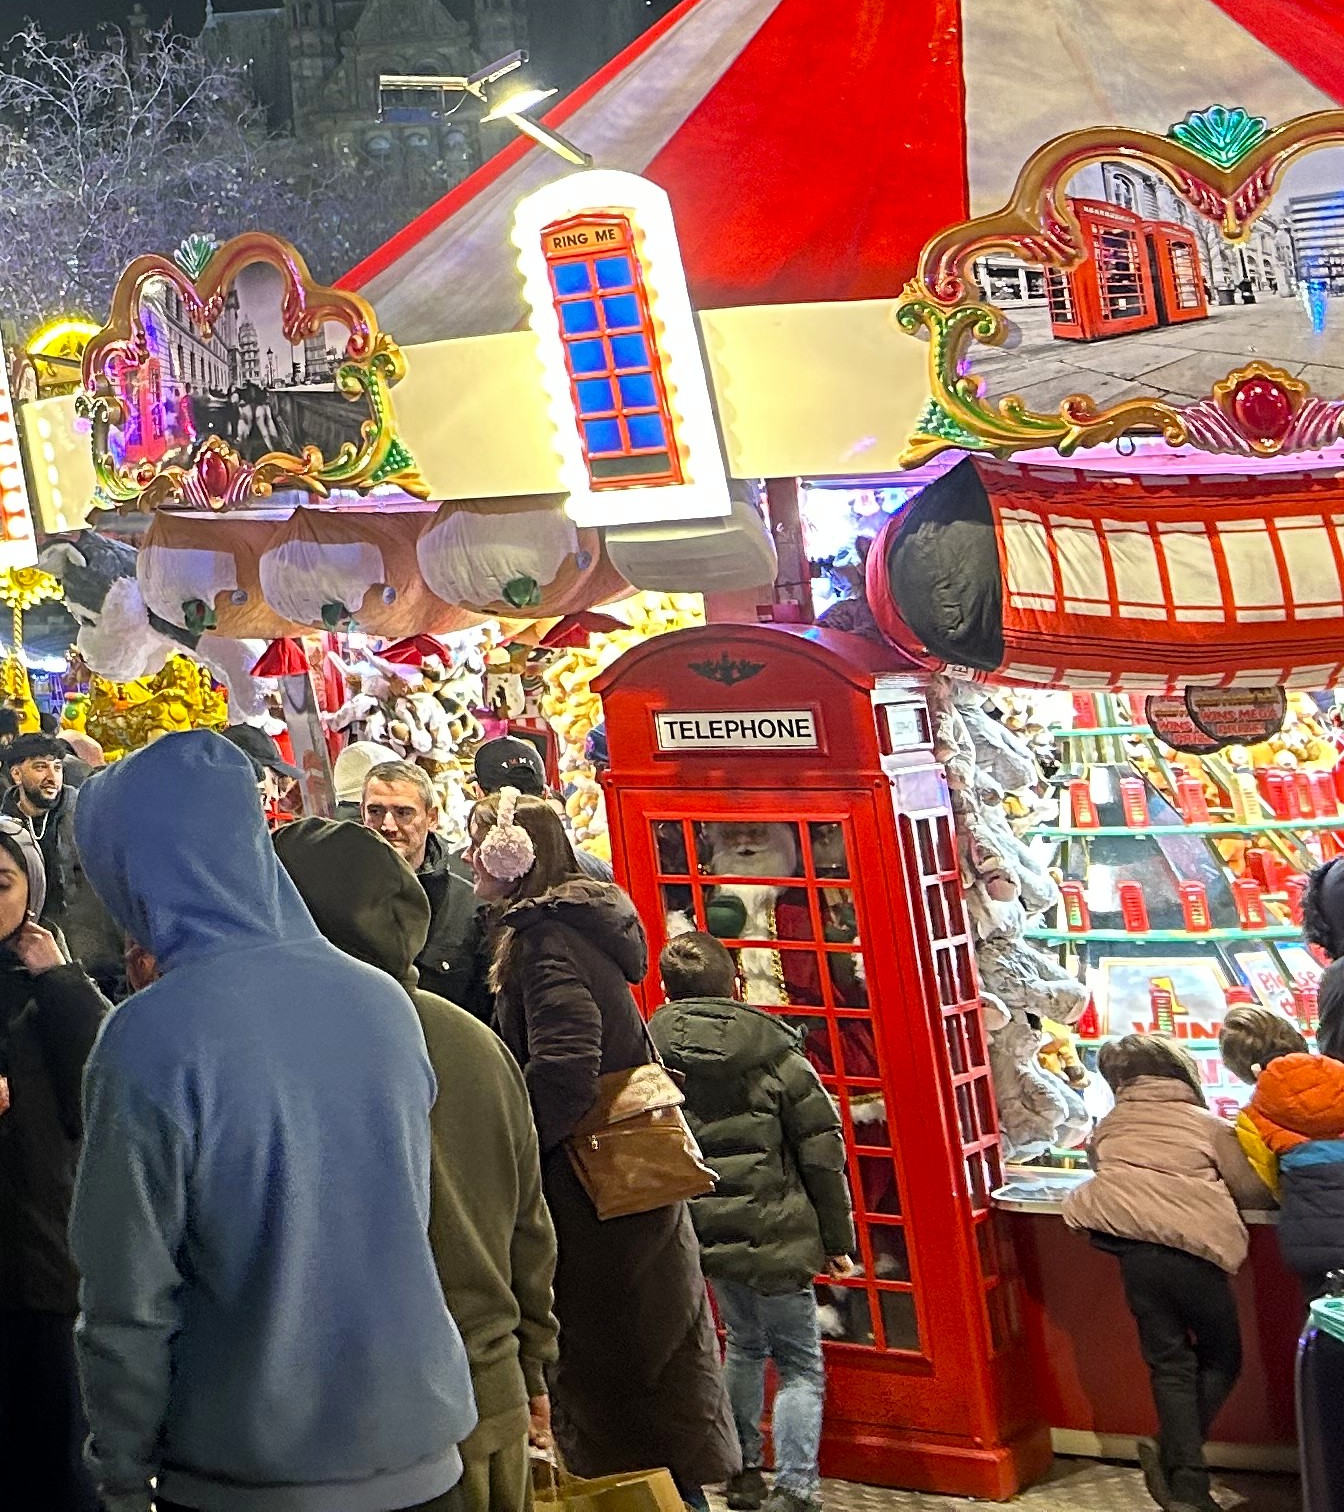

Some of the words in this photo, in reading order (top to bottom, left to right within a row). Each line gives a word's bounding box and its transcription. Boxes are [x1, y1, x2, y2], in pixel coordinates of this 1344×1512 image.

[553, 233, 588, 249] RING
[595, 228, 616, 242] ME
[664, 718, 813, 740] TELEPHONE
